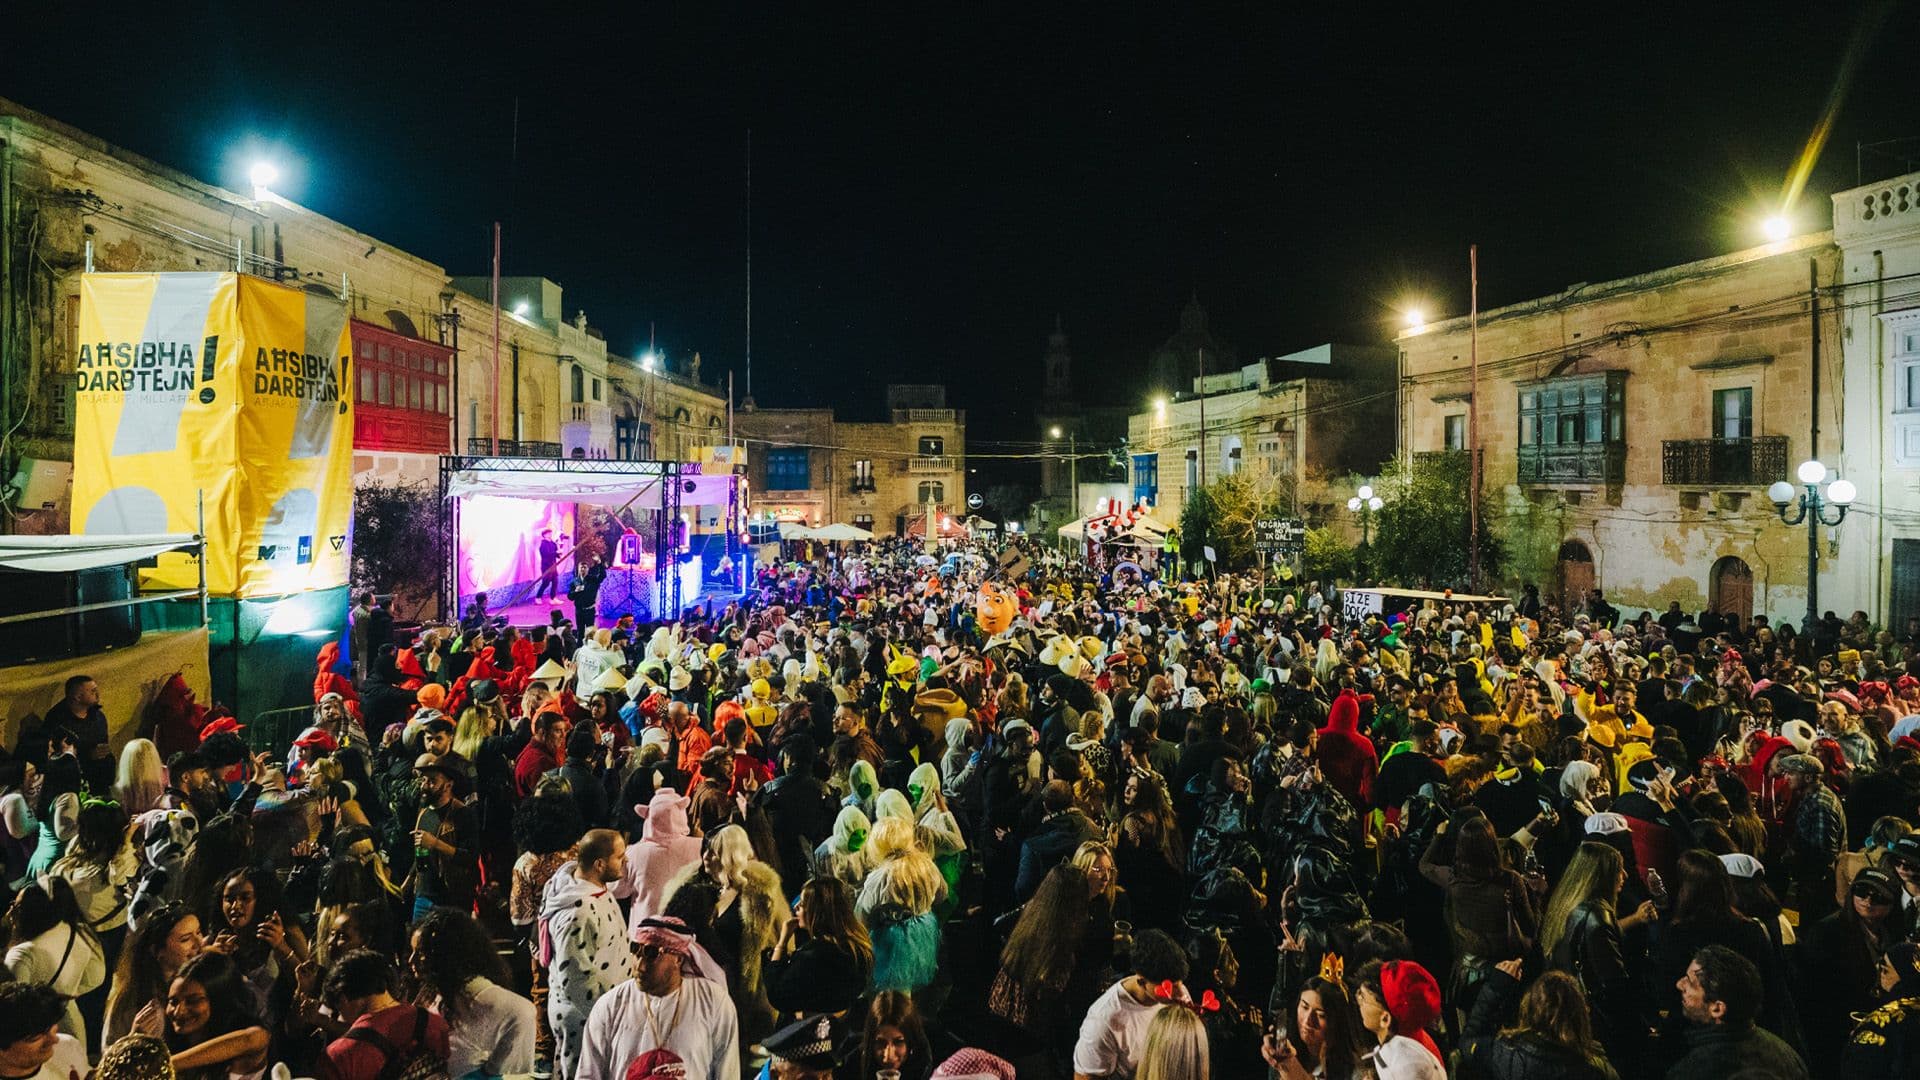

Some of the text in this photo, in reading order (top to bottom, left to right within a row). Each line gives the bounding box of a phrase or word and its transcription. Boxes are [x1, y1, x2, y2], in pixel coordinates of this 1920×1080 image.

[77, 342, 195, 369] AĦSIBHA
[255, 346, 337, 383] AĦSIBHA
[76, 368, 195, 392] DARBTEJN
[254, 372, 339, 403] DARBTEJN
[1345, 592, 1370, 606] SIZE
